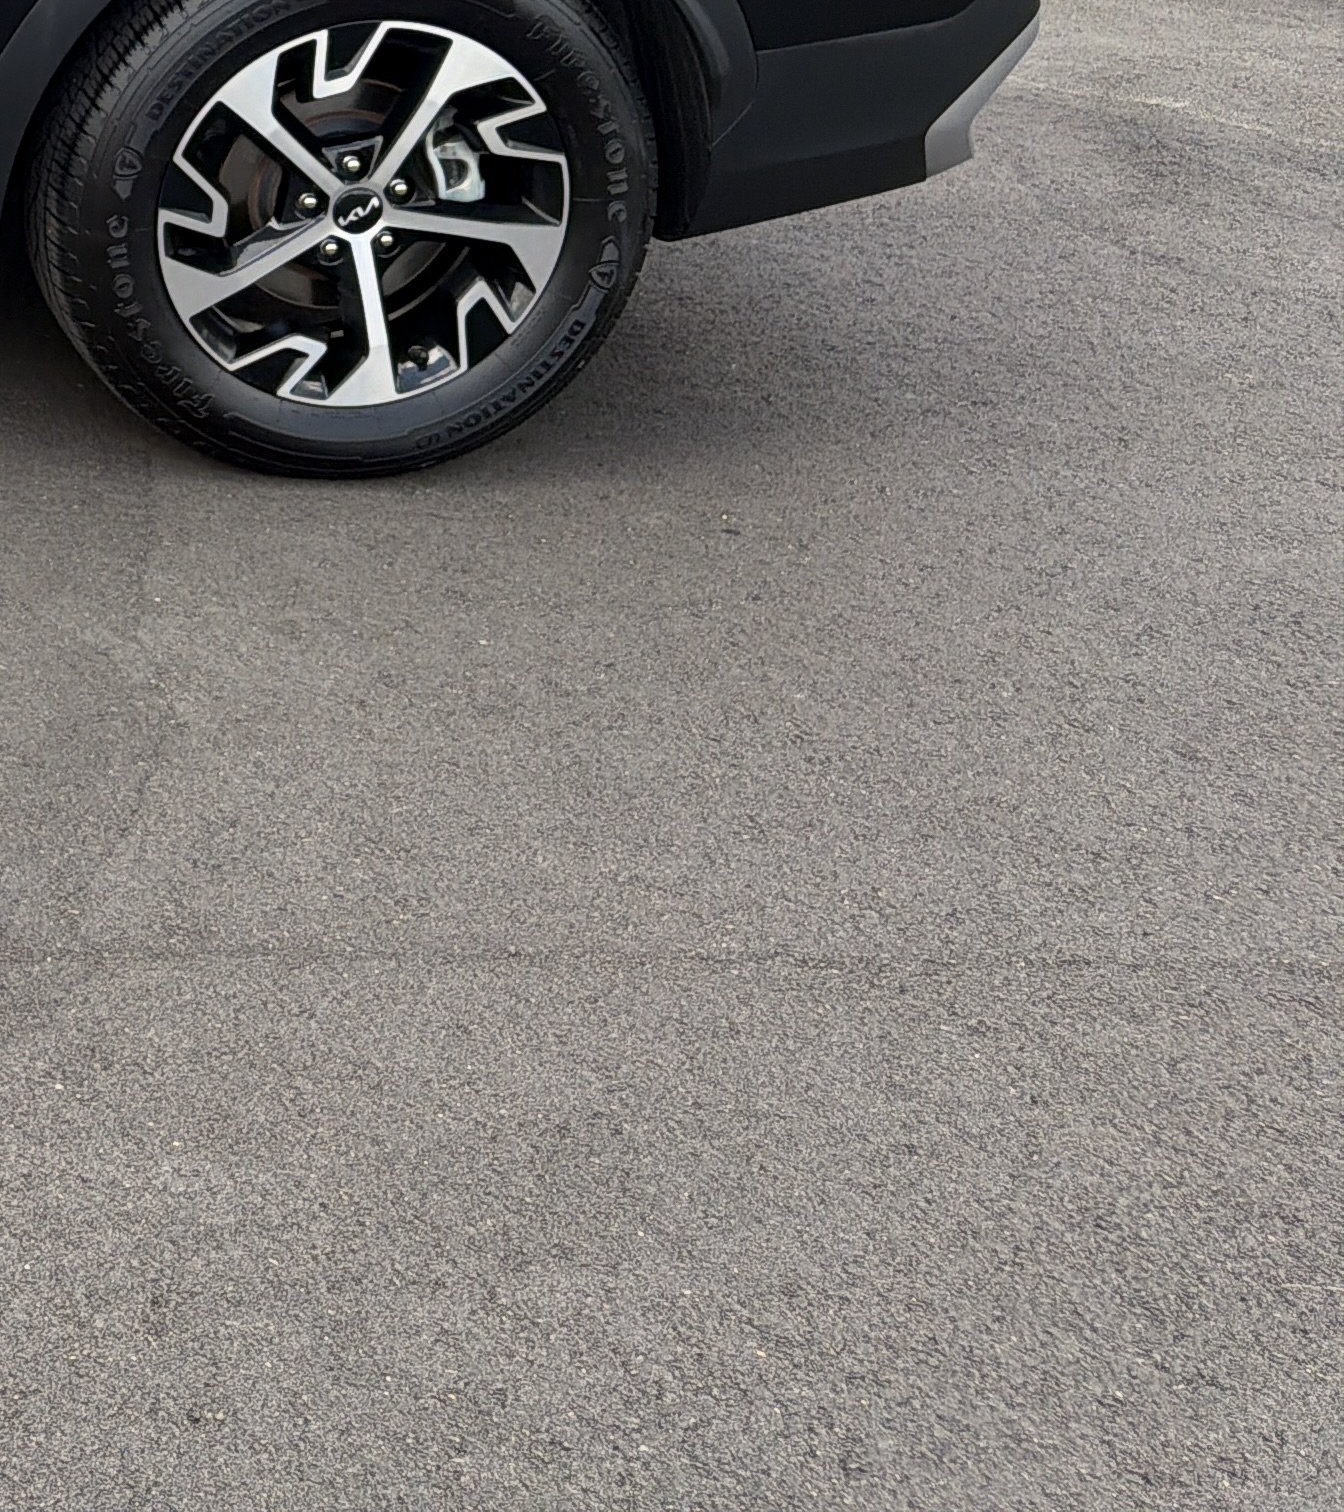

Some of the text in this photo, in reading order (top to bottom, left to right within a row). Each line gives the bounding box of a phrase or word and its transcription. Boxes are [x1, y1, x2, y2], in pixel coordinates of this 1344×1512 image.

[525, 13, 632, 225] Firestone
[105, 214, 217, 419] Firestone
[444, 317, 588, 438] DESTINATION
